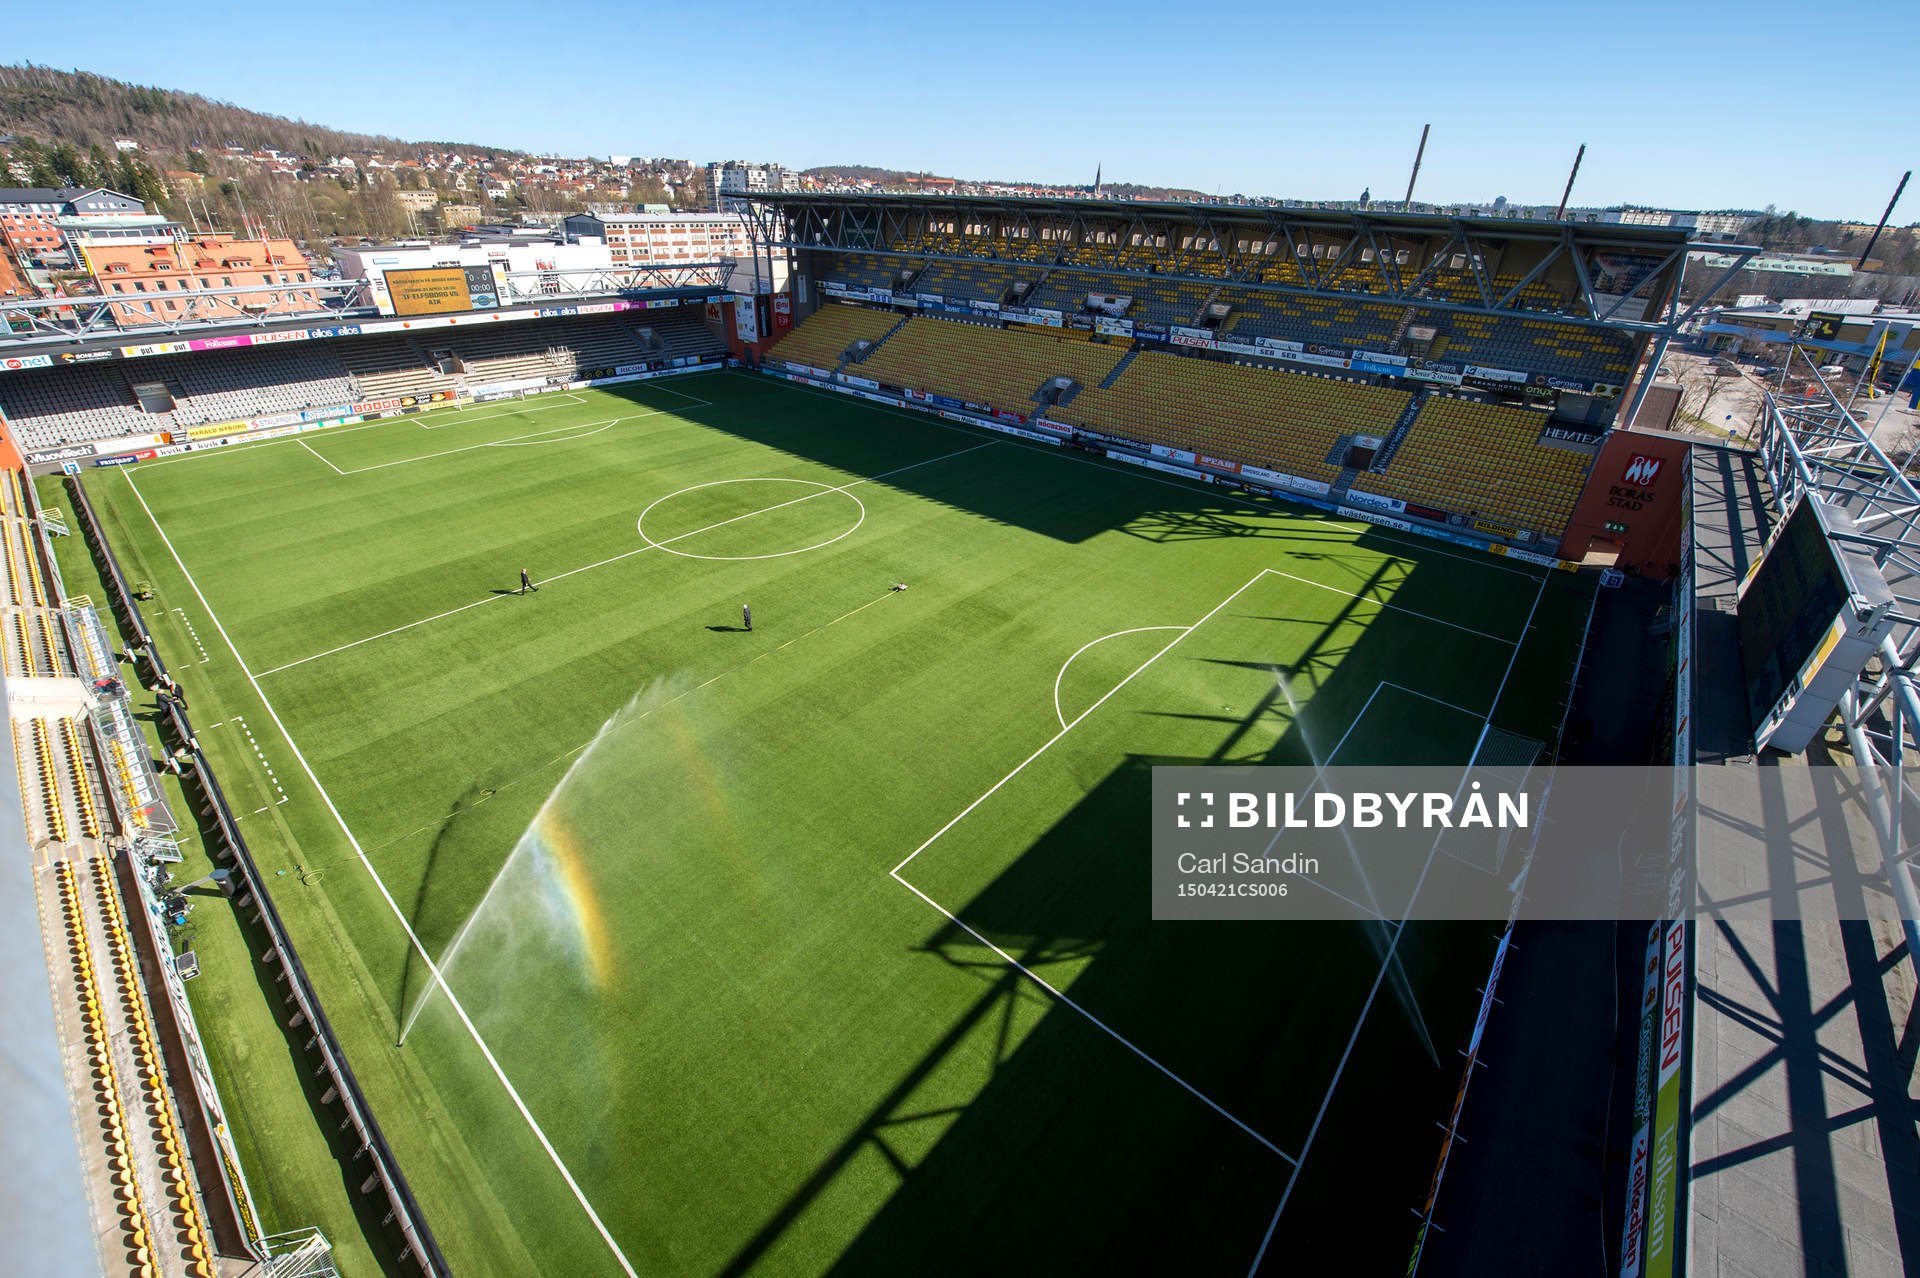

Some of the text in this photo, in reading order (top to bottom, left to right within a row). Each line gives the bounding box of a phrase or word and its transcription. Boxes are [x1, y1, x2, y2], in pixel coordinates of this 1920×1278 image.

[255, 332, 305, 343] PULSEN
[312, 328, 333, 338] ellos
[338, 327, 359, 336] ellos
[1173, 336, 1209, 348] PULSEN
[620, 365, 643, 373] RICOH
[1526, 385, 1554, 398] onyx
[1545, 427, 1602, 445] HEMTEX
[1608, 485, 1655, 502] BORÅS
[1607, 498, 1643, 511] STAD
[1476, 521, 1517, 536] HILDINGS
[1660, 923, 1684, 1072] PULSEN
[1651, 1124, 1677, 1259] Folksam
